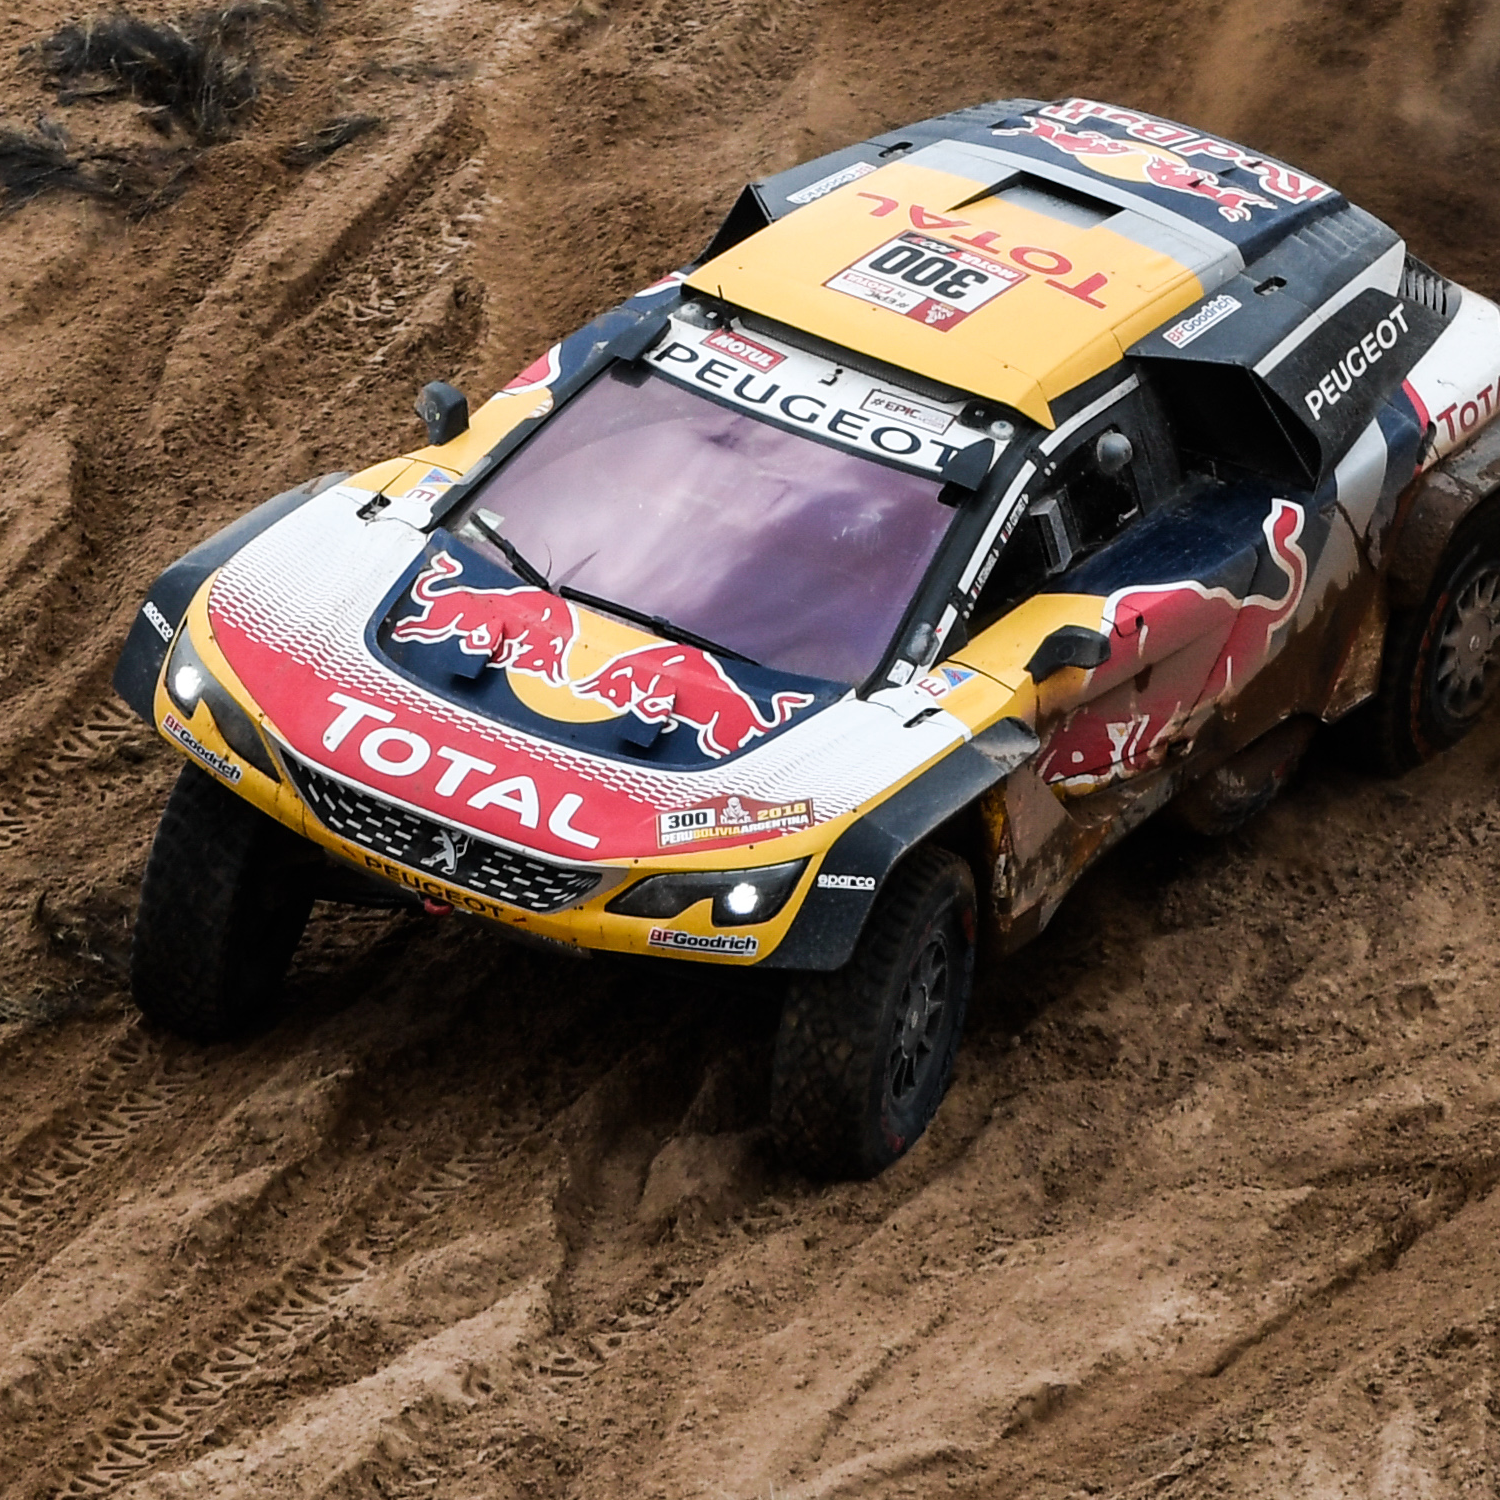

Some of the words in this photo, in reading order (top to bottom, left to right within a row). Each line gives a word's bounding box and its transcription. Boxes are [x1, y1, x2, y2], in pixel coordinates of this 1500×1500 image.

[856, 192, 1109, 310] TOTAL
[868, 245, 990, 300] 300
[1167, 297, 1235, 342] BFGoodrich
[710, 333, 776, 370] MOTUL
[1304, 303, 1413, 421] PEUGEOT
[653, 342, 966, 468] PEUGEOT
[144, 601, 175, 639] sparco
[164, 714, 242, 780] BFGoodrich
[322, 692, 601, 849] TOTAL
[667, 812, 708, 830] 300
[757, 802, 807, 821] 2018
[364, 854, 505, 918] PEUGEOT
[817, 874, 876, 888] sparco
[650, 929, 758, 950] BFGoodrich
